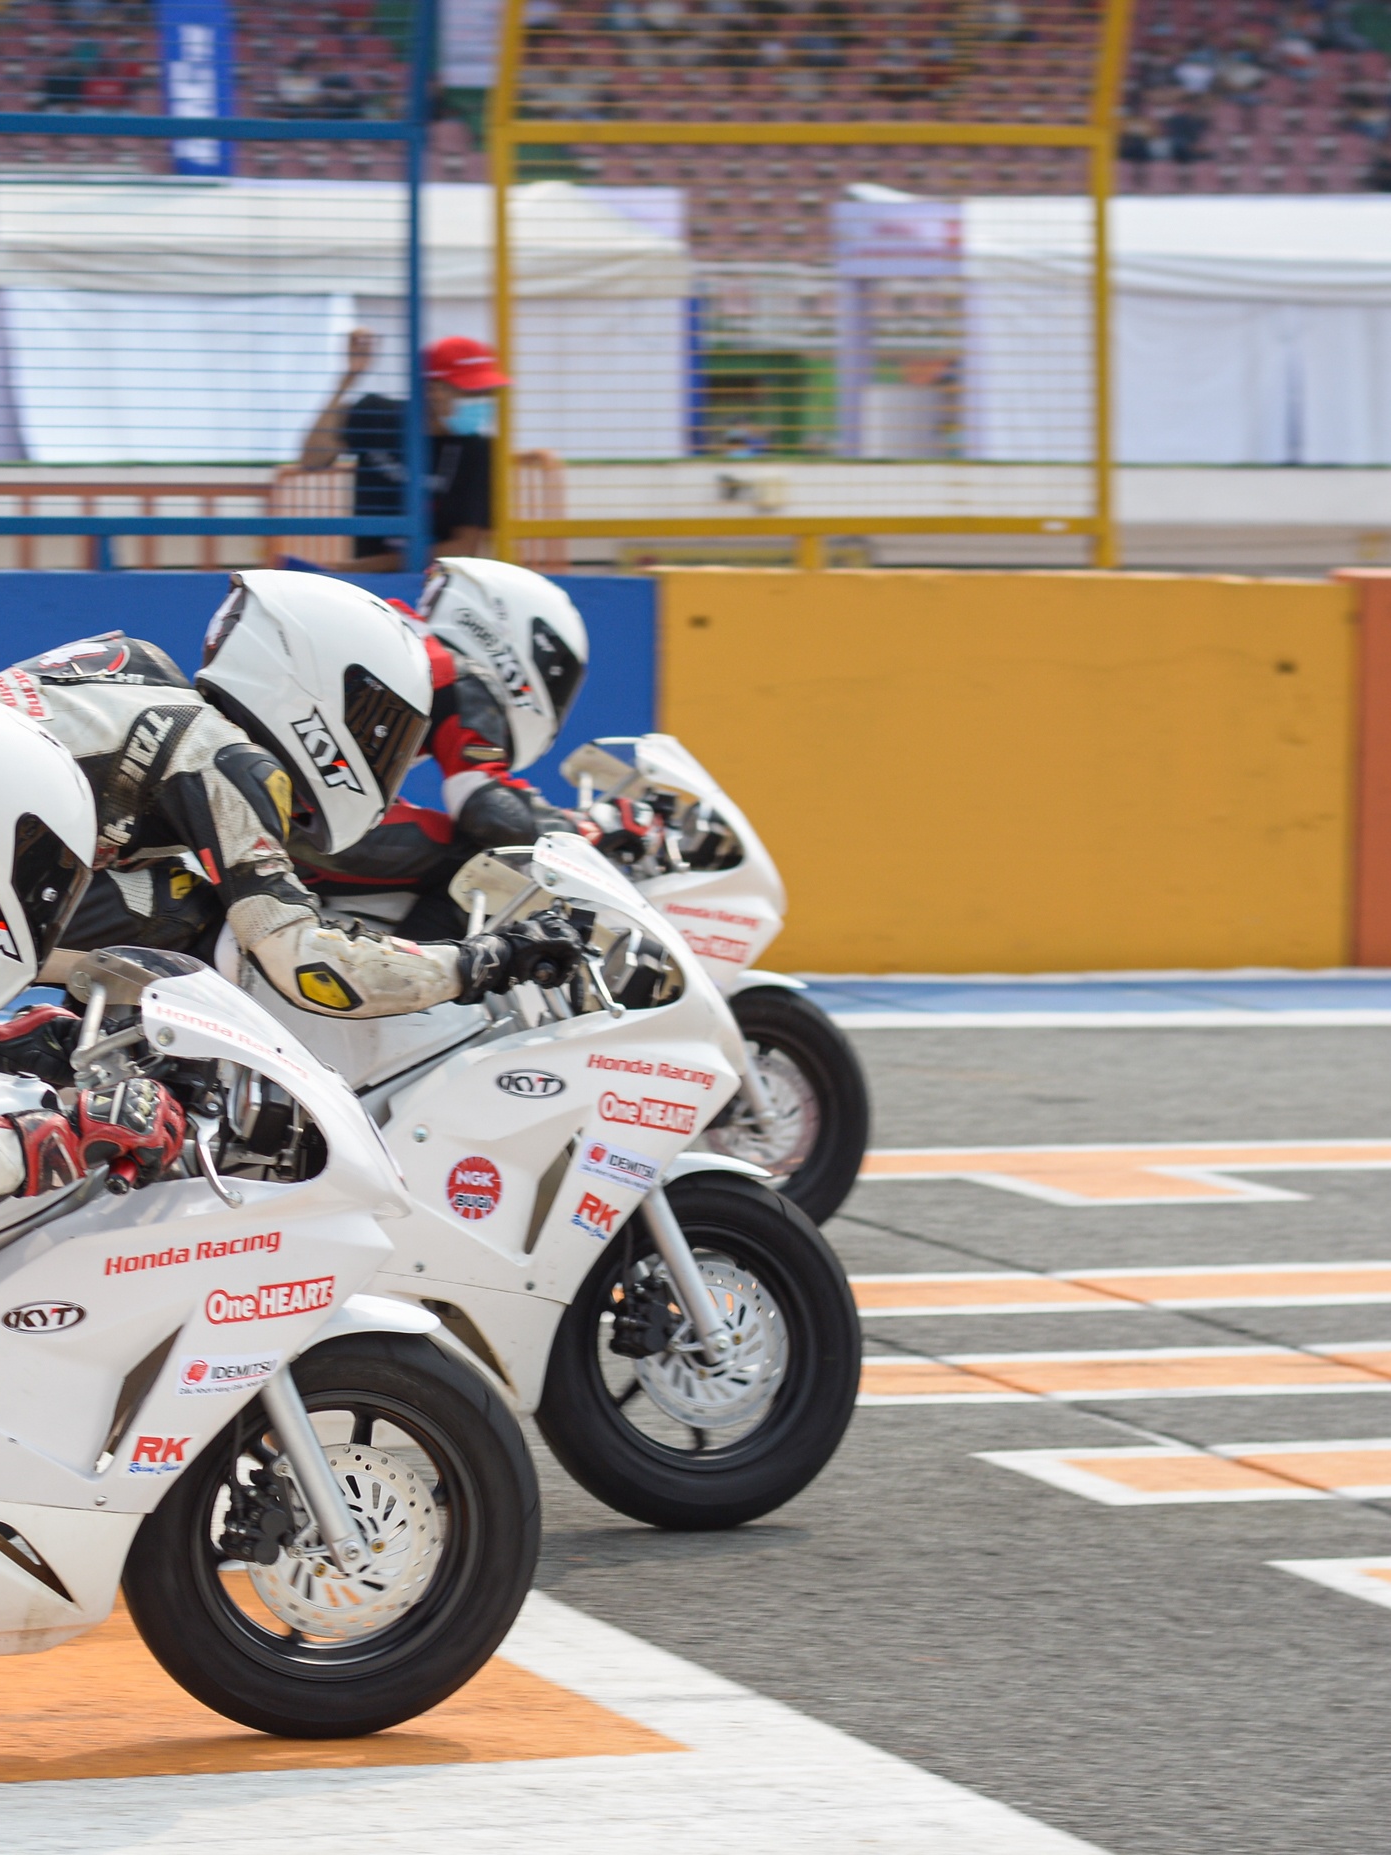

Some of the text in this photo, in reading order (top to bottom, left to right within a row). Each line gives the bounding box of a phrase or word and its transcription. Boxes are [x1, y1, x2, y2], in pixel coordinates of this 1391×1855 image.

[290, 704, 367, 796] KYT
[155, 1006, 310, 1080] Honda Racing
[497, 1074, 559, 1093] KYT
[586, 1053, 716, 1090] Honda Racing
[598, 1091, 641, 1124] One
[455, 1170, 495, 1187] NGK
[455, 1194, 492, 1210] BUGI
[576, 1191, 621, 1232] RK
[104, 1231, 282, 1276] Honda Racing
[3, 1306, 73, 1329] KYT
[207, 1289, 258, 1325] One
[210, 1360, 278, 1380] IDEMITSU
[131, 1435, 192, 1462] RK
